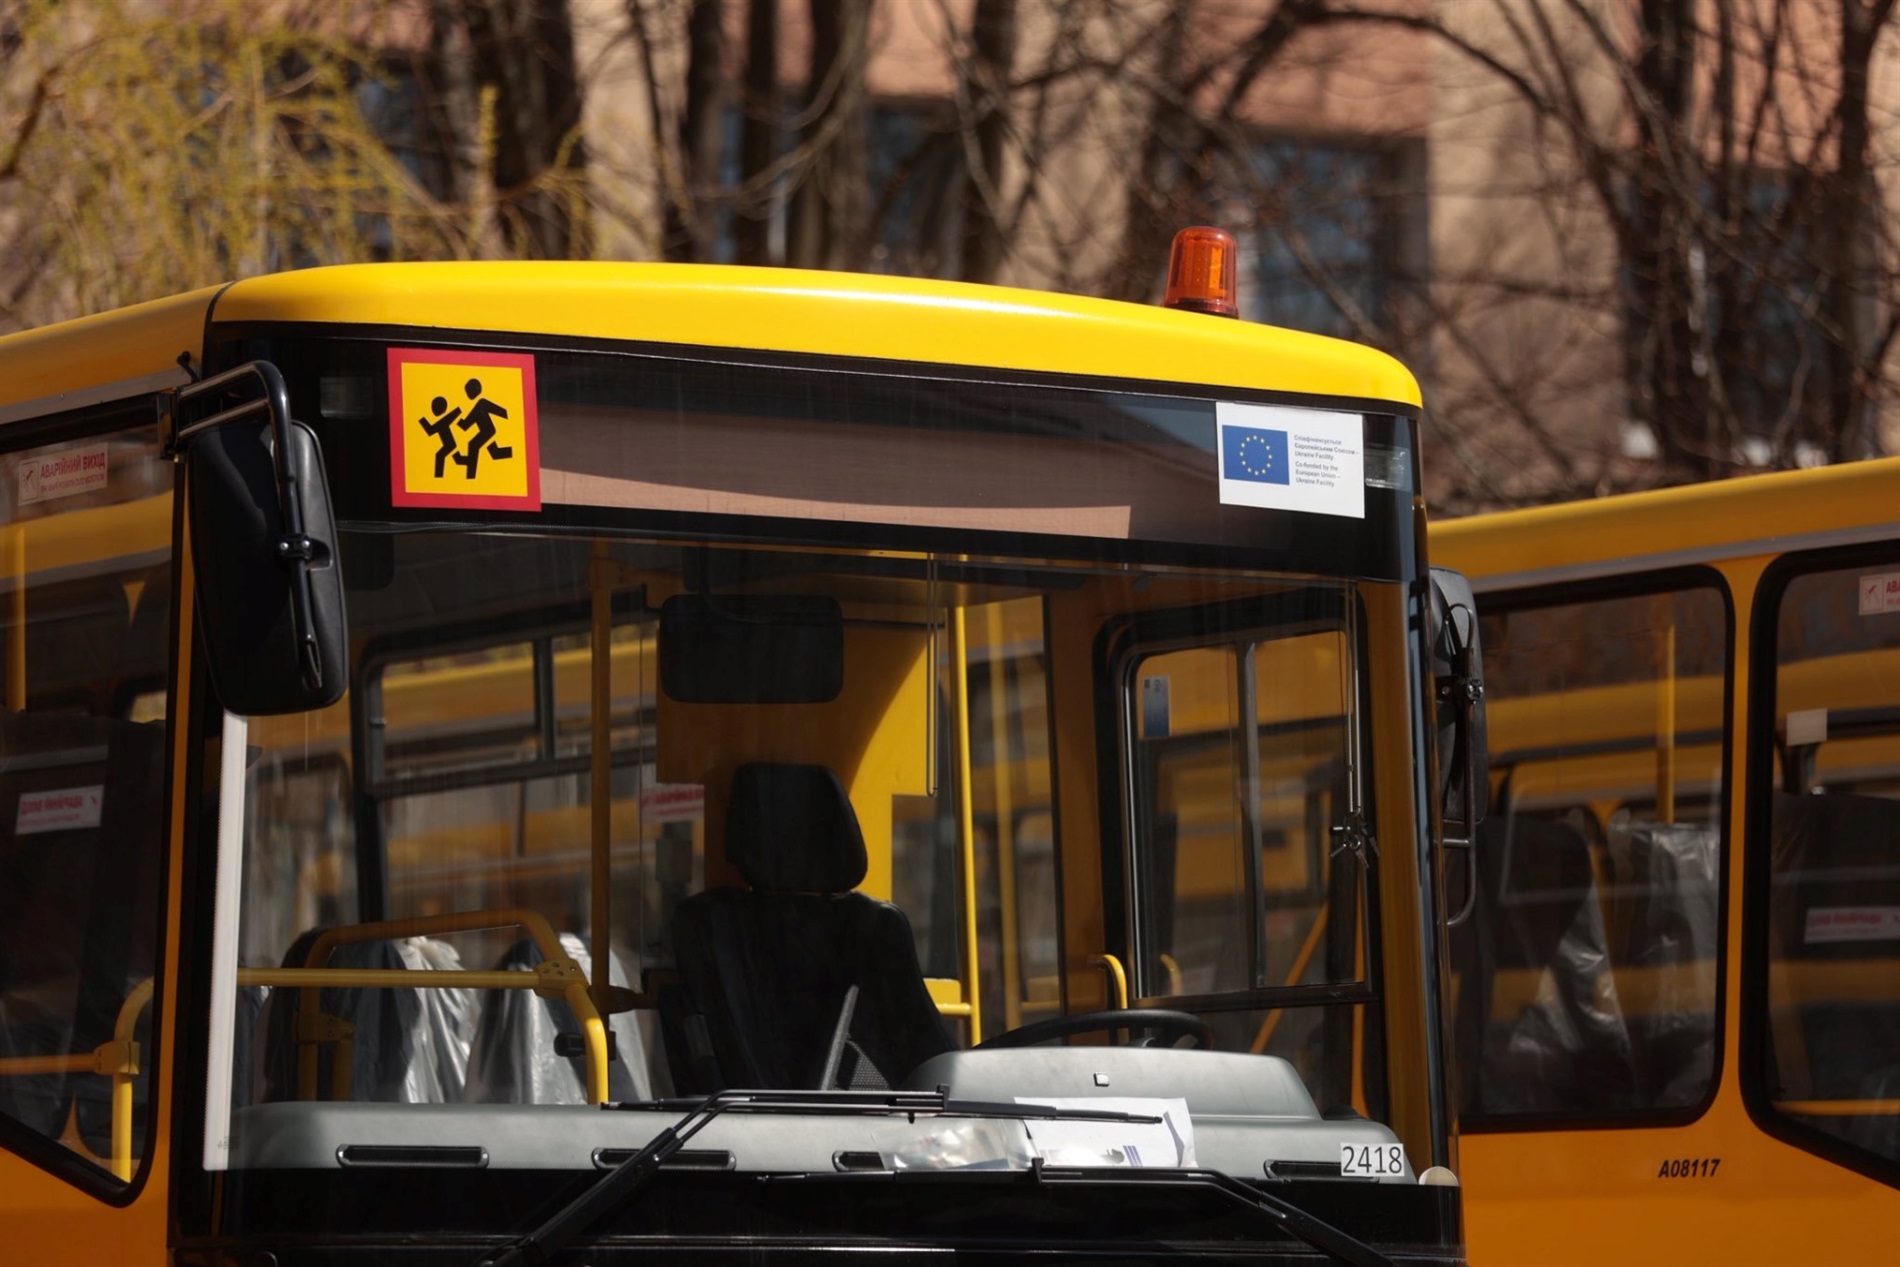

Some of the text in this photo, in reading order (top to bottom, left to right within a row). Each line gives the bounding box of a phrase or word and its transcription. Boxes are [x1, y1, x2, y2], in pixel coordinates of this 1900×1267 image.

[1315, 453, 1334, 461] Facility
[41, 453, 105, 478] АВАРІЙНИЙ ВИХІД
[1295, 461, 1321, 470] Co-funded
[1323, 463, 1329, 471] by
[1296, 469, 1320, 477] European
[1316, 479, 1334, 487] Facility
[1343, 1146, 1402, 1173] 2418
[1658, 1159, 1721, 1178] A08117
